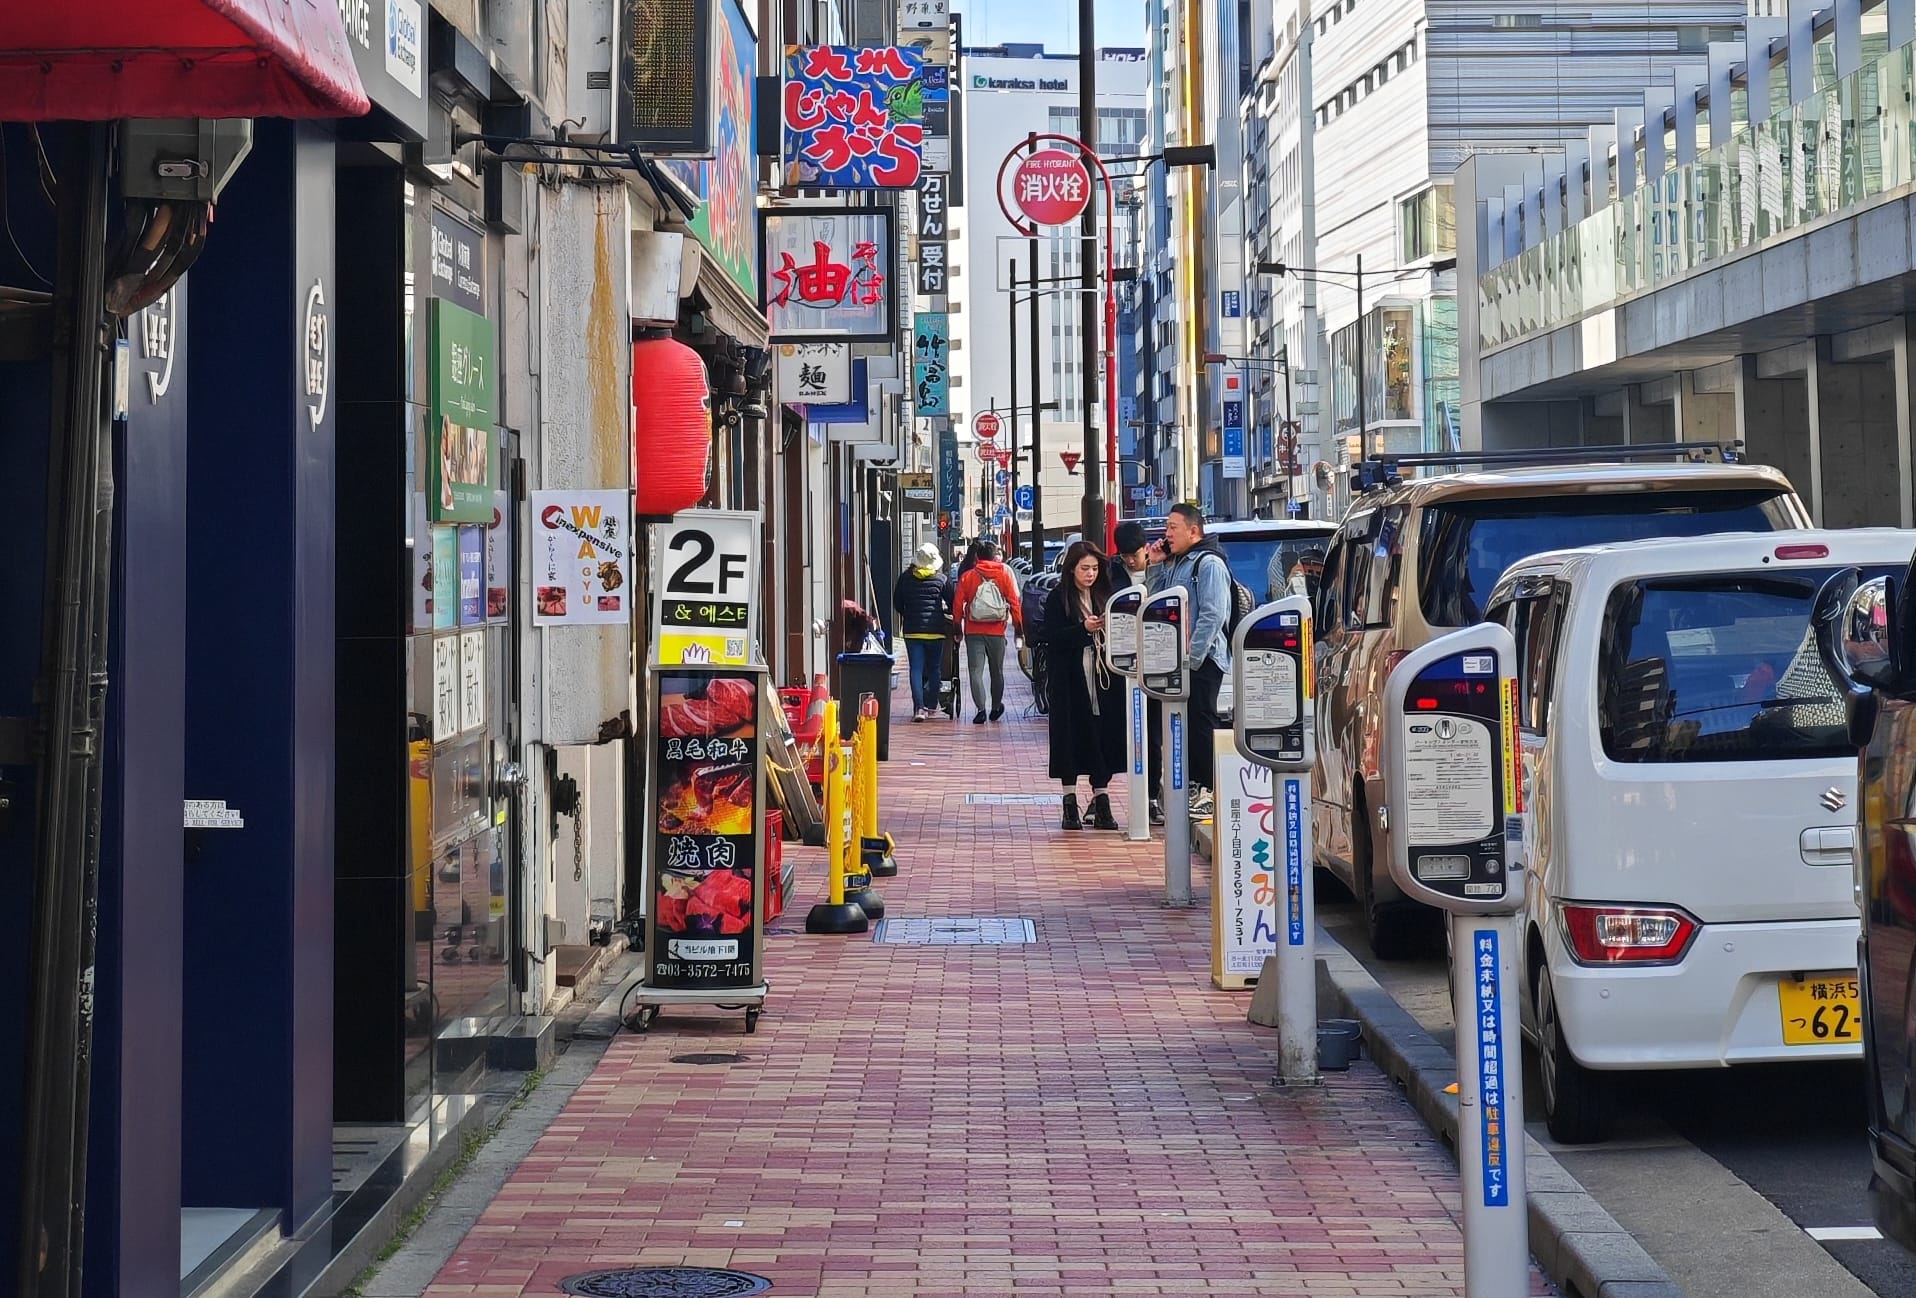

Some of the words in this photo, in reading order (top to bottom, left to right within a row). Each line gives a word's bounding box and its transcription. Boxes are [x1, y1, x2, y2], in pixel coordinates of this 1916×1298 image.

[803, 44, 916, 81] 九州
[988, 77, 1035, 90] karaksa
[1039, 78, 1068, 91] hotel
[784, 80, 889, 133] じゃん
[800, 123, 923, 187] がら
[1026, 160, 1041, 169] FIRE
[1043, 160, 1077, 169] HYDRANT
[1020, 172, 1084, 203] 消火栓
[771, 239, 853, 309] 油
[921, 245, 944, 291] 受付
[1020, 491, 1031, 507] P
[555, 515, 623, 559] inexpensive
[666, 529, 748, 595] 2F
[674, 603, 693, 621] &
[665, 737, 749, 761] 黒毛和牛
[667, 836, 736, 868] 焼肉
[1789, 1017, 1807, 1029] つ
